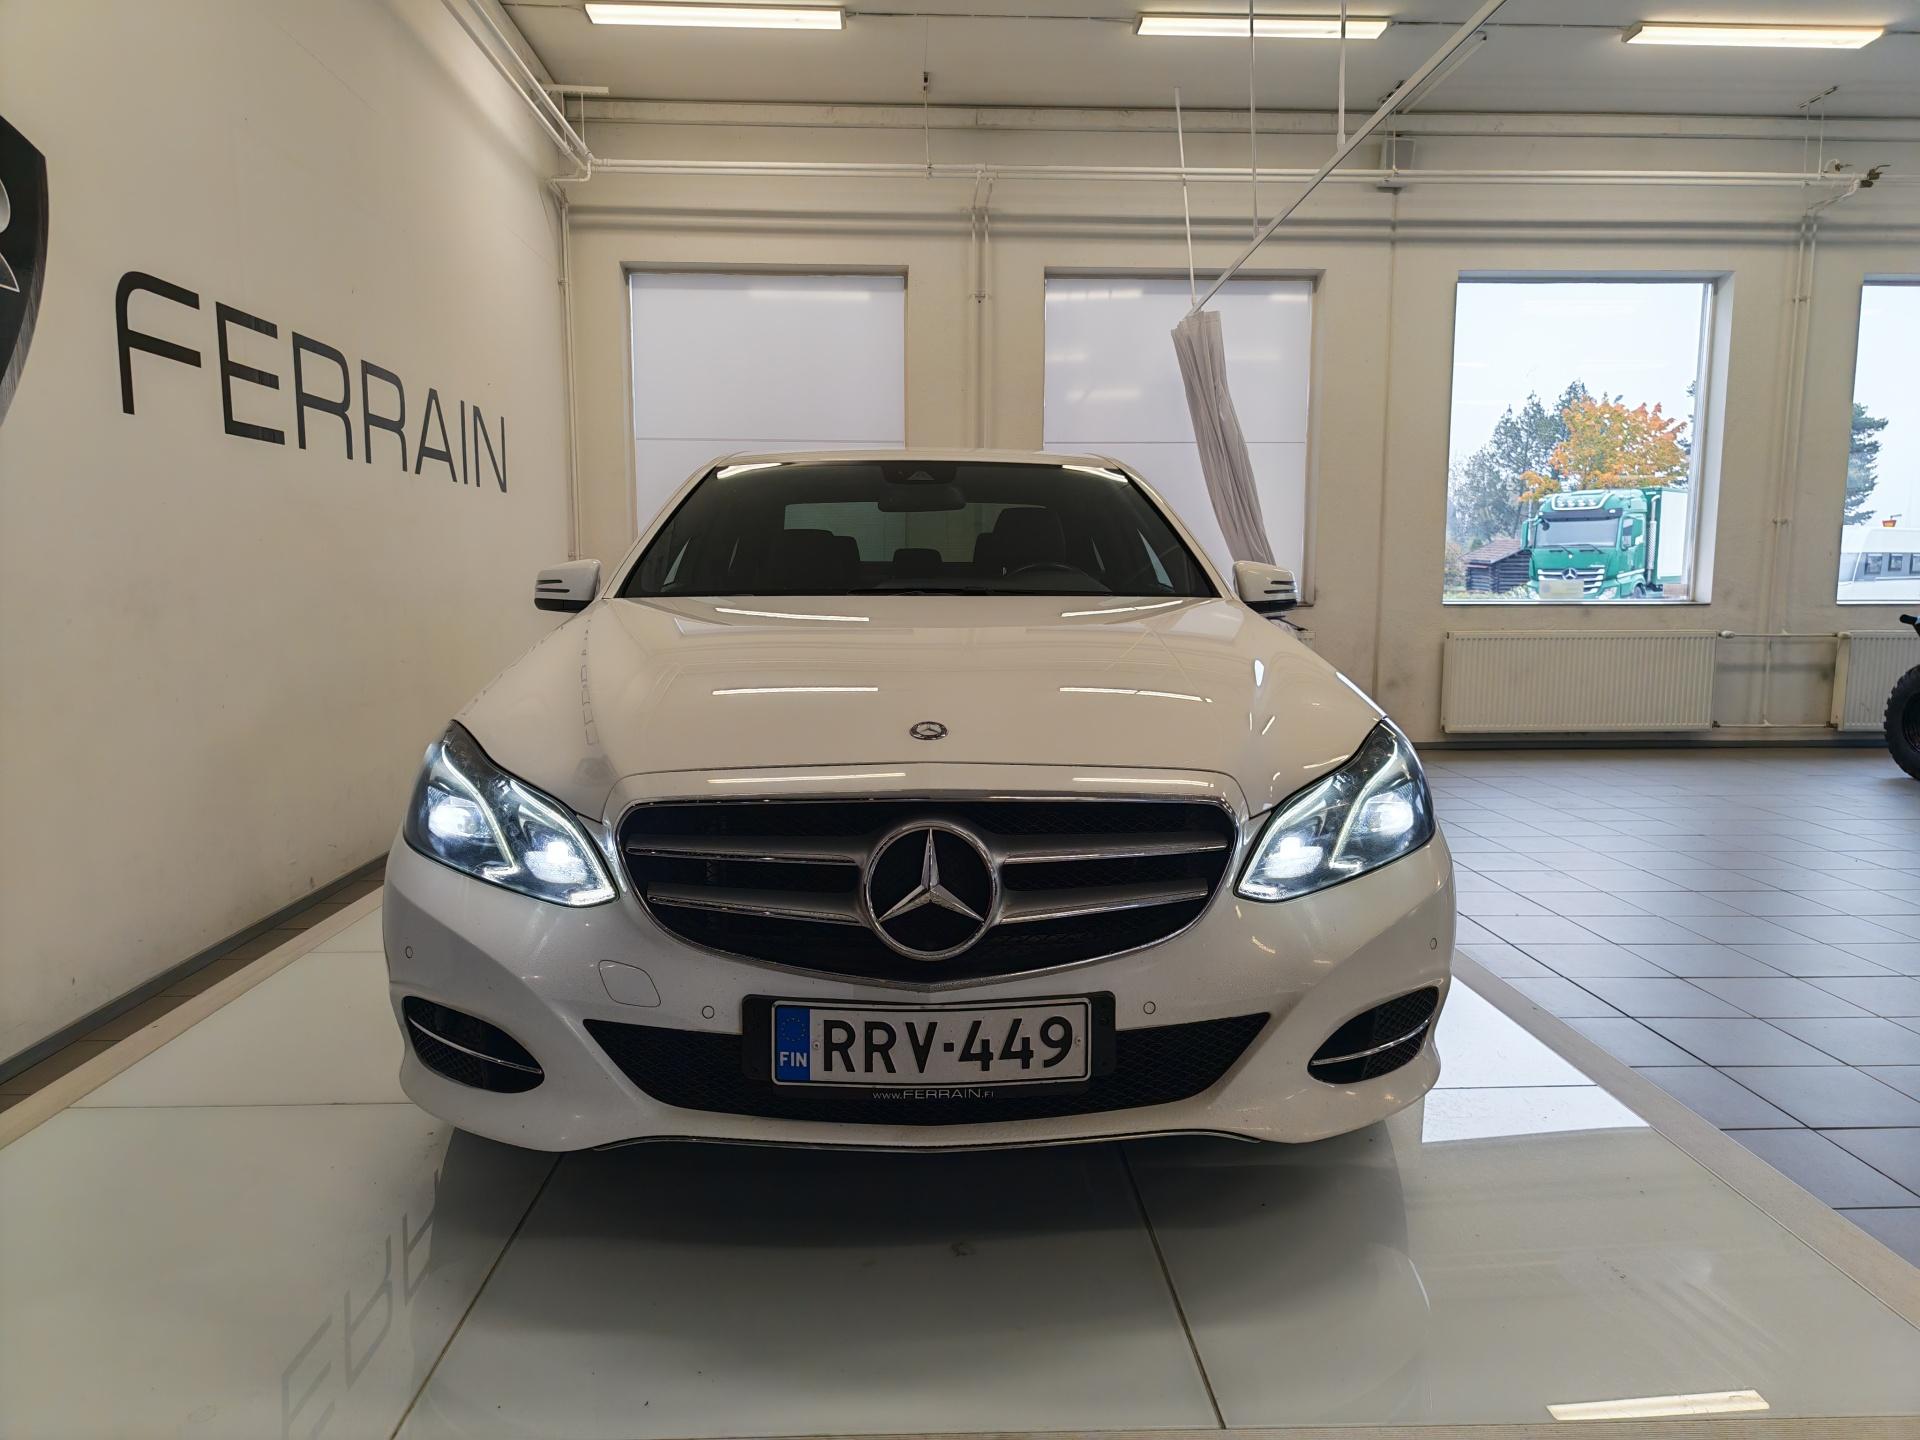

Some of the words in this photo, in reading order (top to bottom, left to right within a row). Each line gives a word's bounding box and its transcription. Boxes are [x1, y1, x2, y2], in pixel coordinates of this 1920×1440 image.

[116, 271, 507, 493] FERRAIN
[779, 1052, 807, 1067] FIN
[823, 1016, 1073, 1073] RRV-449
